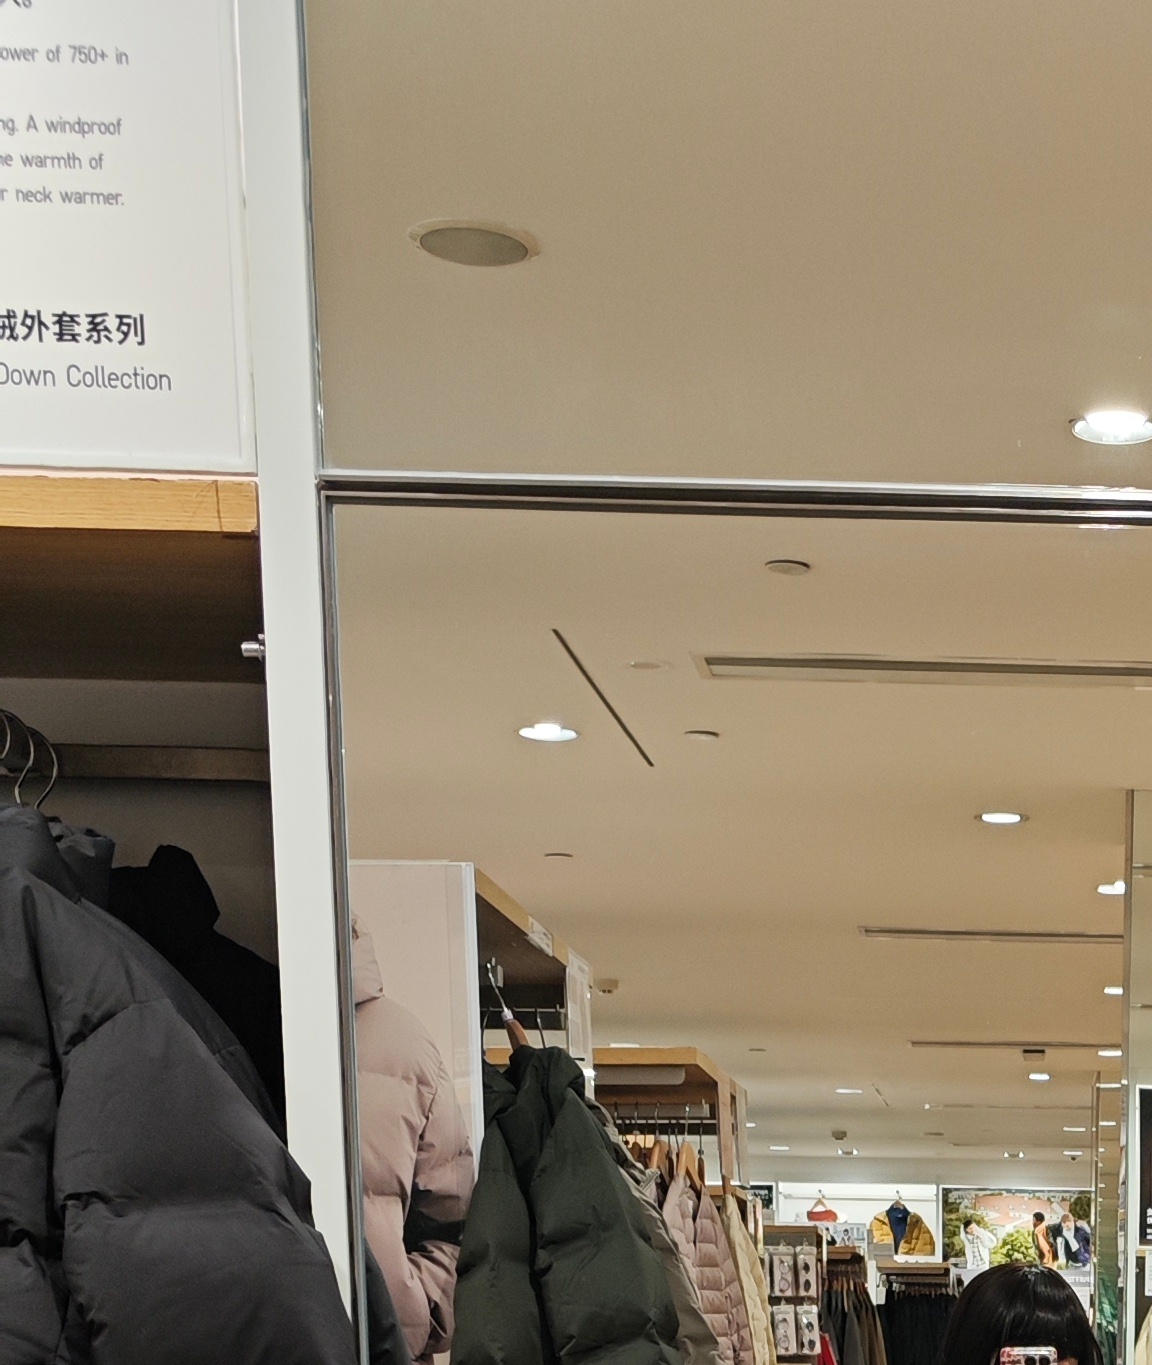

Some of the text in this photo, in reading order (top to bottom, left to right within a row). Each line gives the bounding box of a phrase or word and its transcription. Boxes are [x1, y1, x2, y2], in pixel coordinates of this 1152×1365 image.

[46, 45, 61, 63] of
[68, 45, 108, 65] 750+
[115, 46, 129, 65] in
[26, 114, 39, 132] A
[45, 115, 122, 139] windproof
[20, 152, 82, 170] warmth
[88, 152, 104, 170] of
[15, 186, 53, 203] neck
[59, 190, 125, 206] warmer.
[66, 364, 172, 391] Collection
